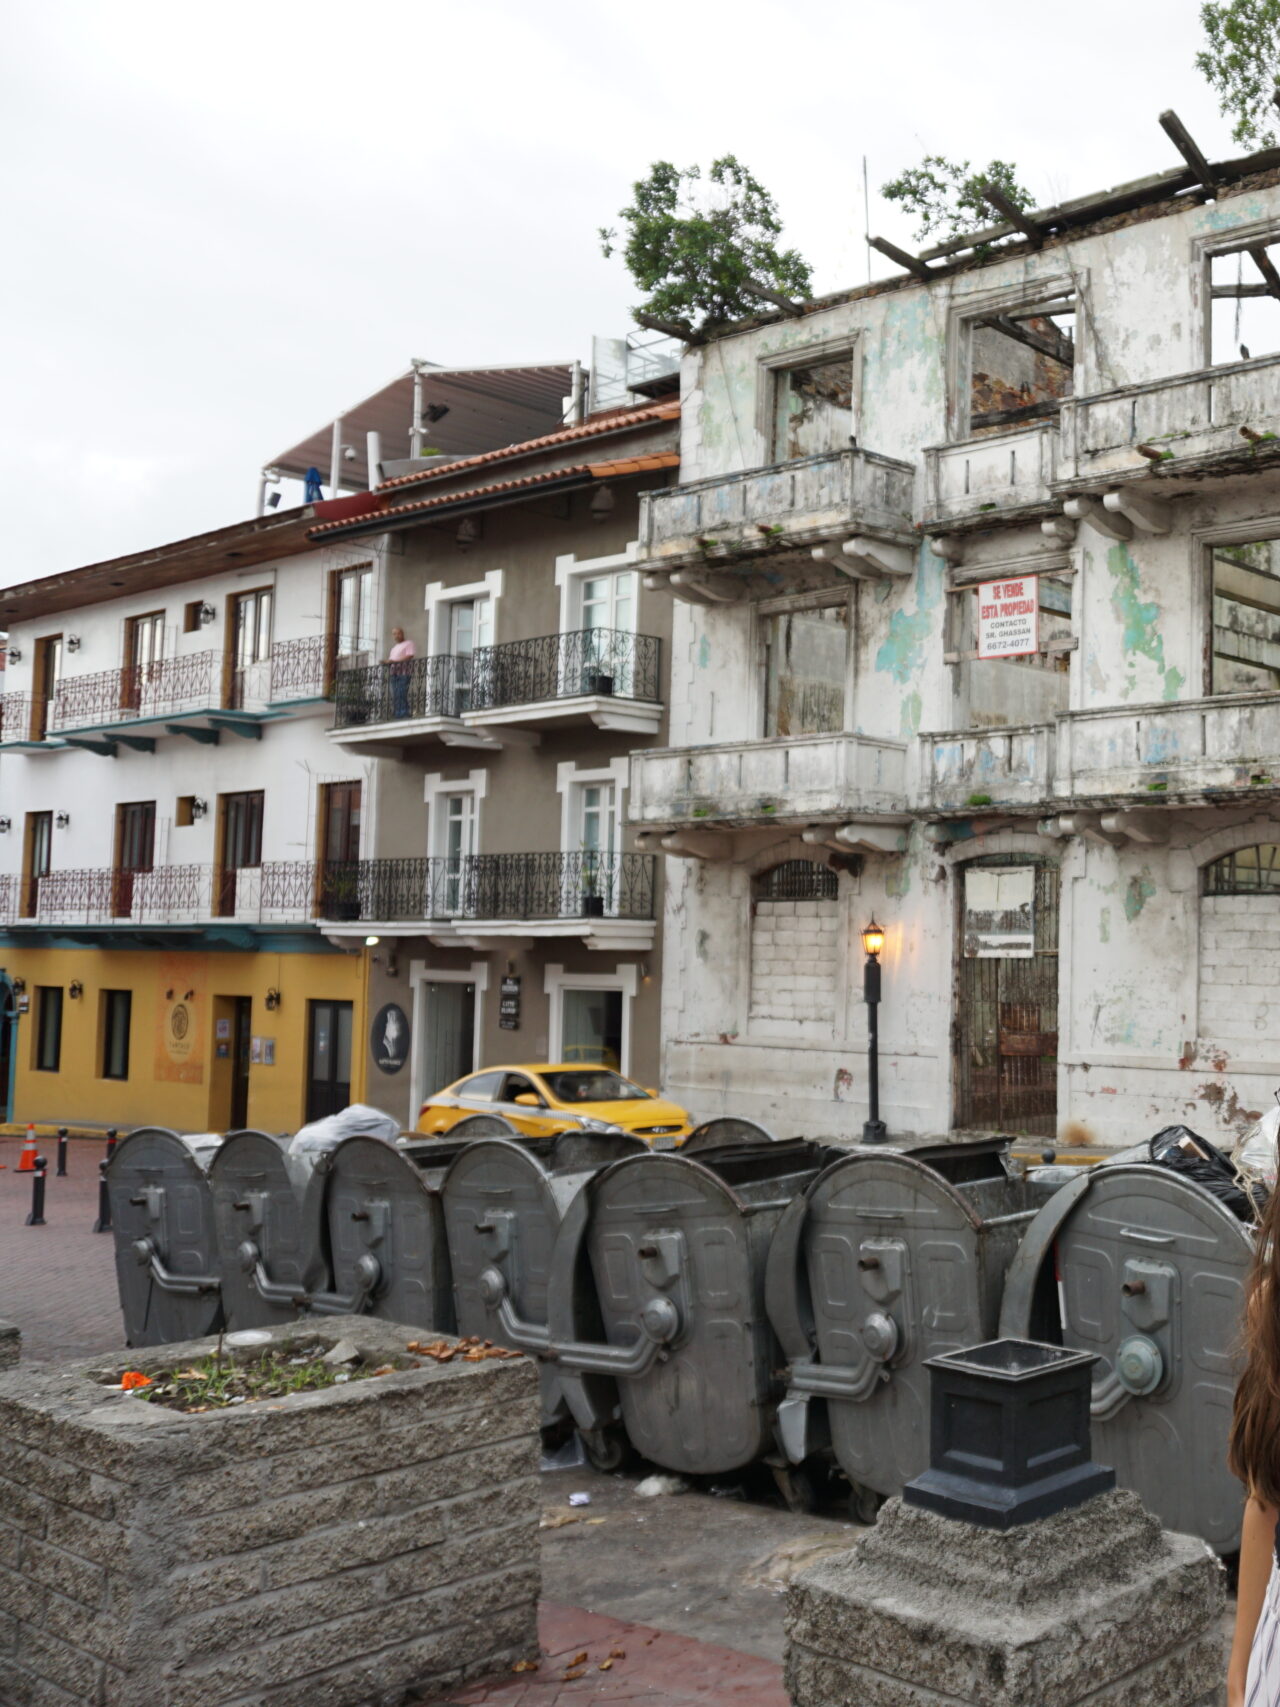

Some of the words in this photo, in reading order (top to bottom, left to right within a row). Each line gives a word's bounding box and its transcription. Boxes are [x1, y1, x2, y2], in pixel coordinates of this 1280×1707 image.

[993, 585, 1001, 600] SE
[1002, 582, 1023, 598] VENDE
[981, 605, 998, 620] ESTA
[1000, 599, 1034, 617] PROPIEDAD
[991, 618, 1026, 629] CONTACTO
[999, 628, 1030, 638] GHASSAN
[987, 639, 1029, 650] 6672-4077
